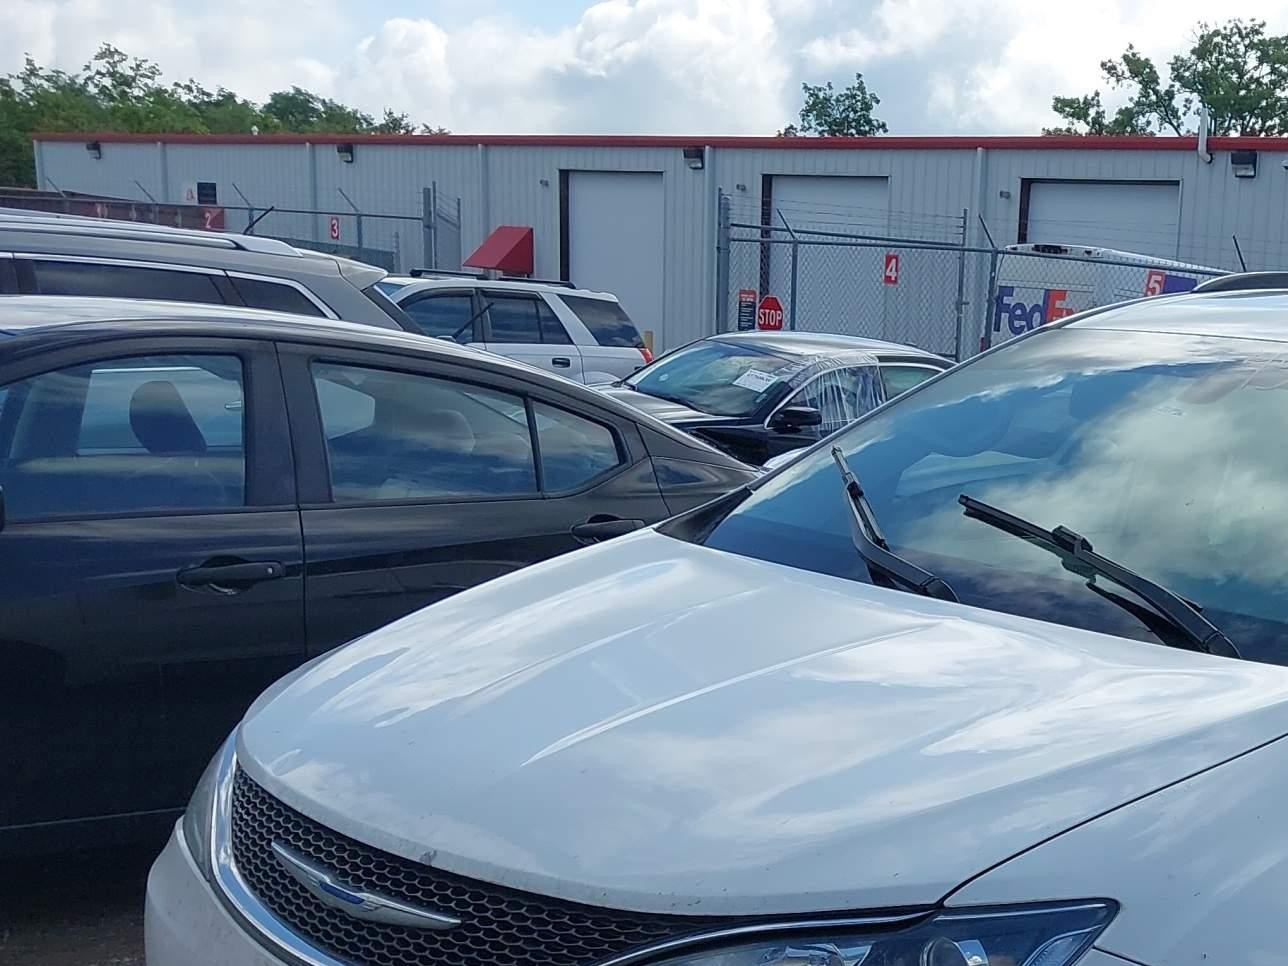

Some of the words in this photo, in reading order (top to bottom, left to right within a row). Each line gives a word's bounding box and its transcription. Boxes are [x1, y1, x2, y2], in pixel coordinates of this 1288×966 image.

[331, 219, 338, 237] 3
[886, 258, 897, 280] 4
[1146, 275, 1162, 296] 5
[758, 309, 783, 326] STOP
